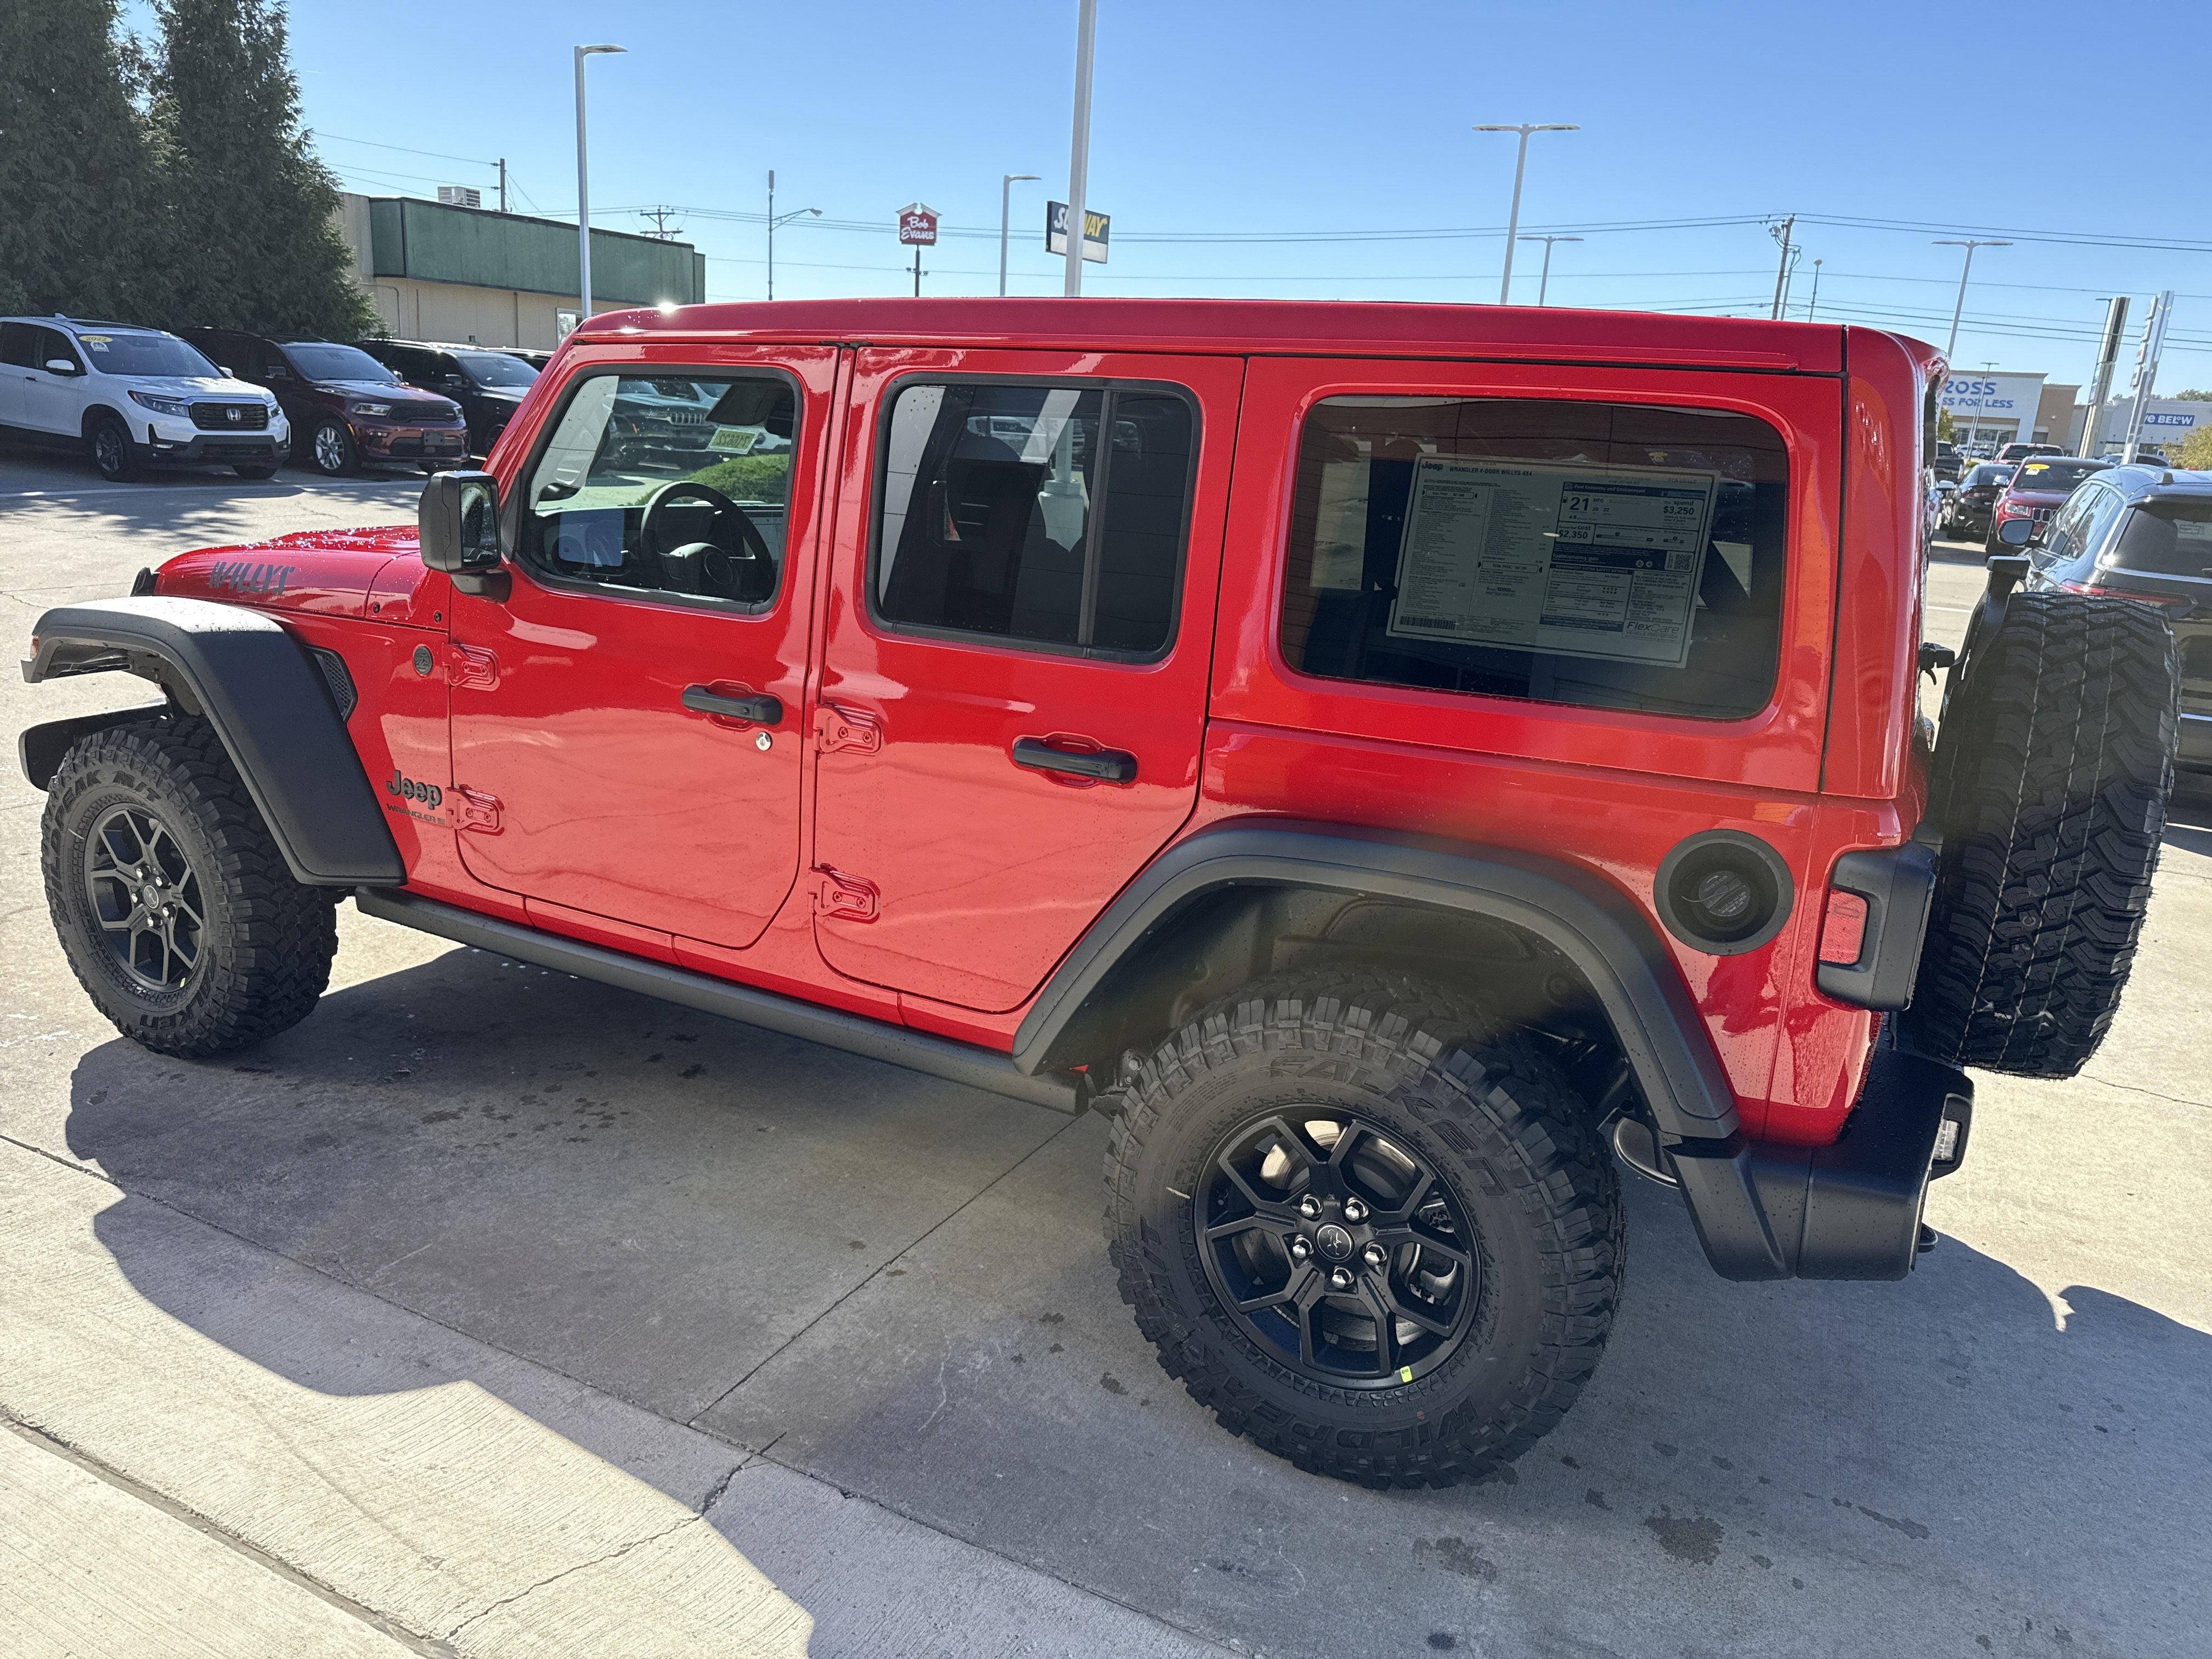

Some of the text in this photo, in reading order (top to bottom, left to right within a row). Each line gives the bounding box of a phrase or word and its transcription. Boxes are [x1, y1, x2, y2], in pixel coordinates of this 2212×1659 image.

[907, 216, 928, 229] Bob
[901, 227, 934, 240] Evans
[1985, 399, 2013, 408] LESS
[1421, 461, 1443, 471] Jeep
[1570, 496, 1589, 511] 21
[1663, 505, 1694, 515] $3,250
[1559, 529, 1588, 539] $2,350
[1553, 553, 1600, 561] fueleconomy.gov
[208, 561, 296, 595] WILLYS
[1627, 621, 1679, 634] FlexCare
[386, 769, 442, 810] Jeep
[386, 803, 436, 822] WRANGLER
[1263, 1056, 1508, 1197] FALKEN
